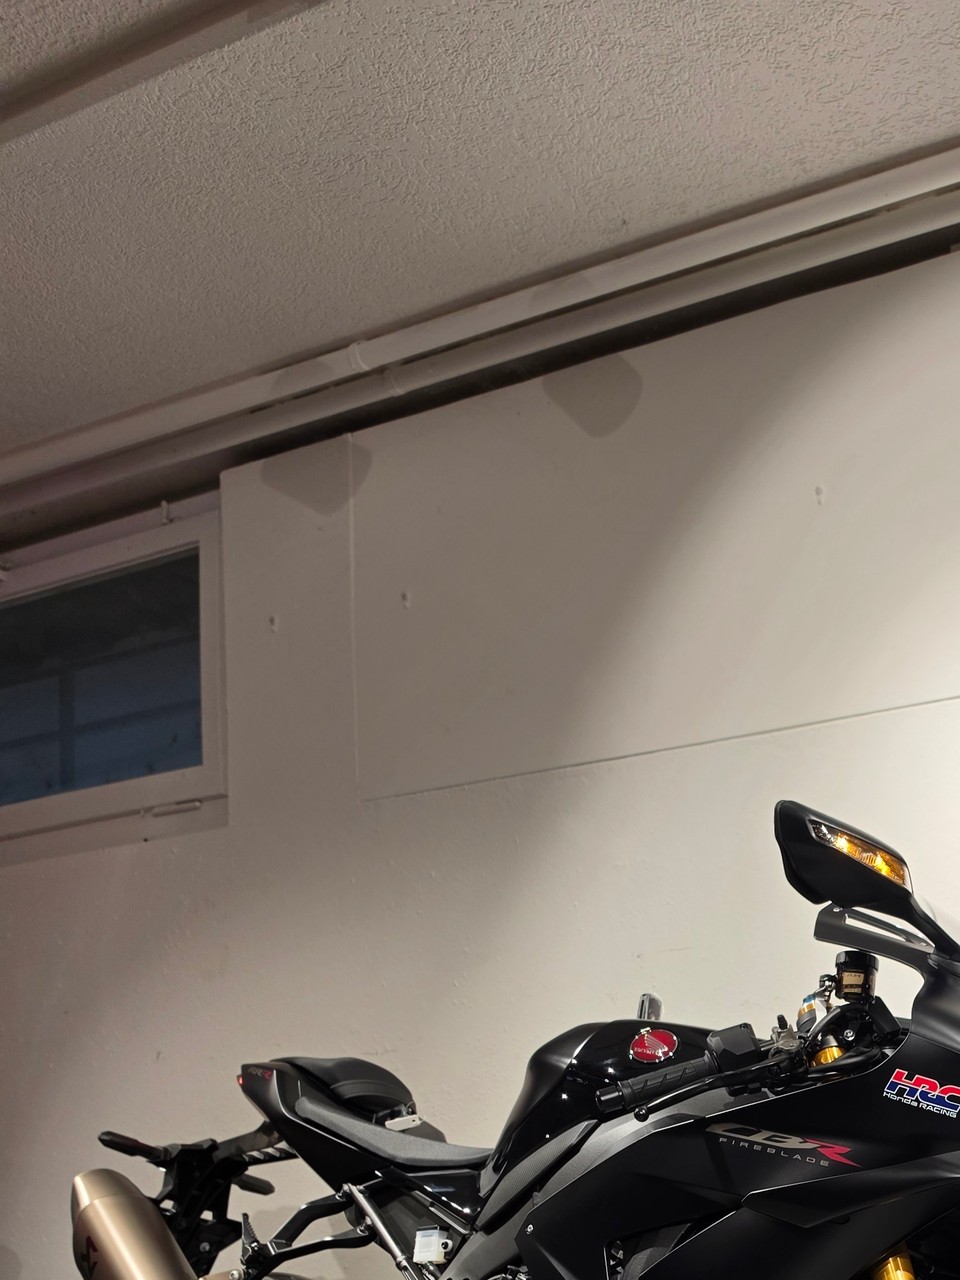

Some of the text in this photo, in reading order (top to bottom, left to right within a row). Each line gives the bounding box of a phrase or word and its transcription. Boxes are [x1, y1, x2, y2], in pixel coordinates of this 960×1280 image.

[882, 1091, 957, 1118] Honda RACING
[719, 1137, 831, 1168] FIREBLADE
